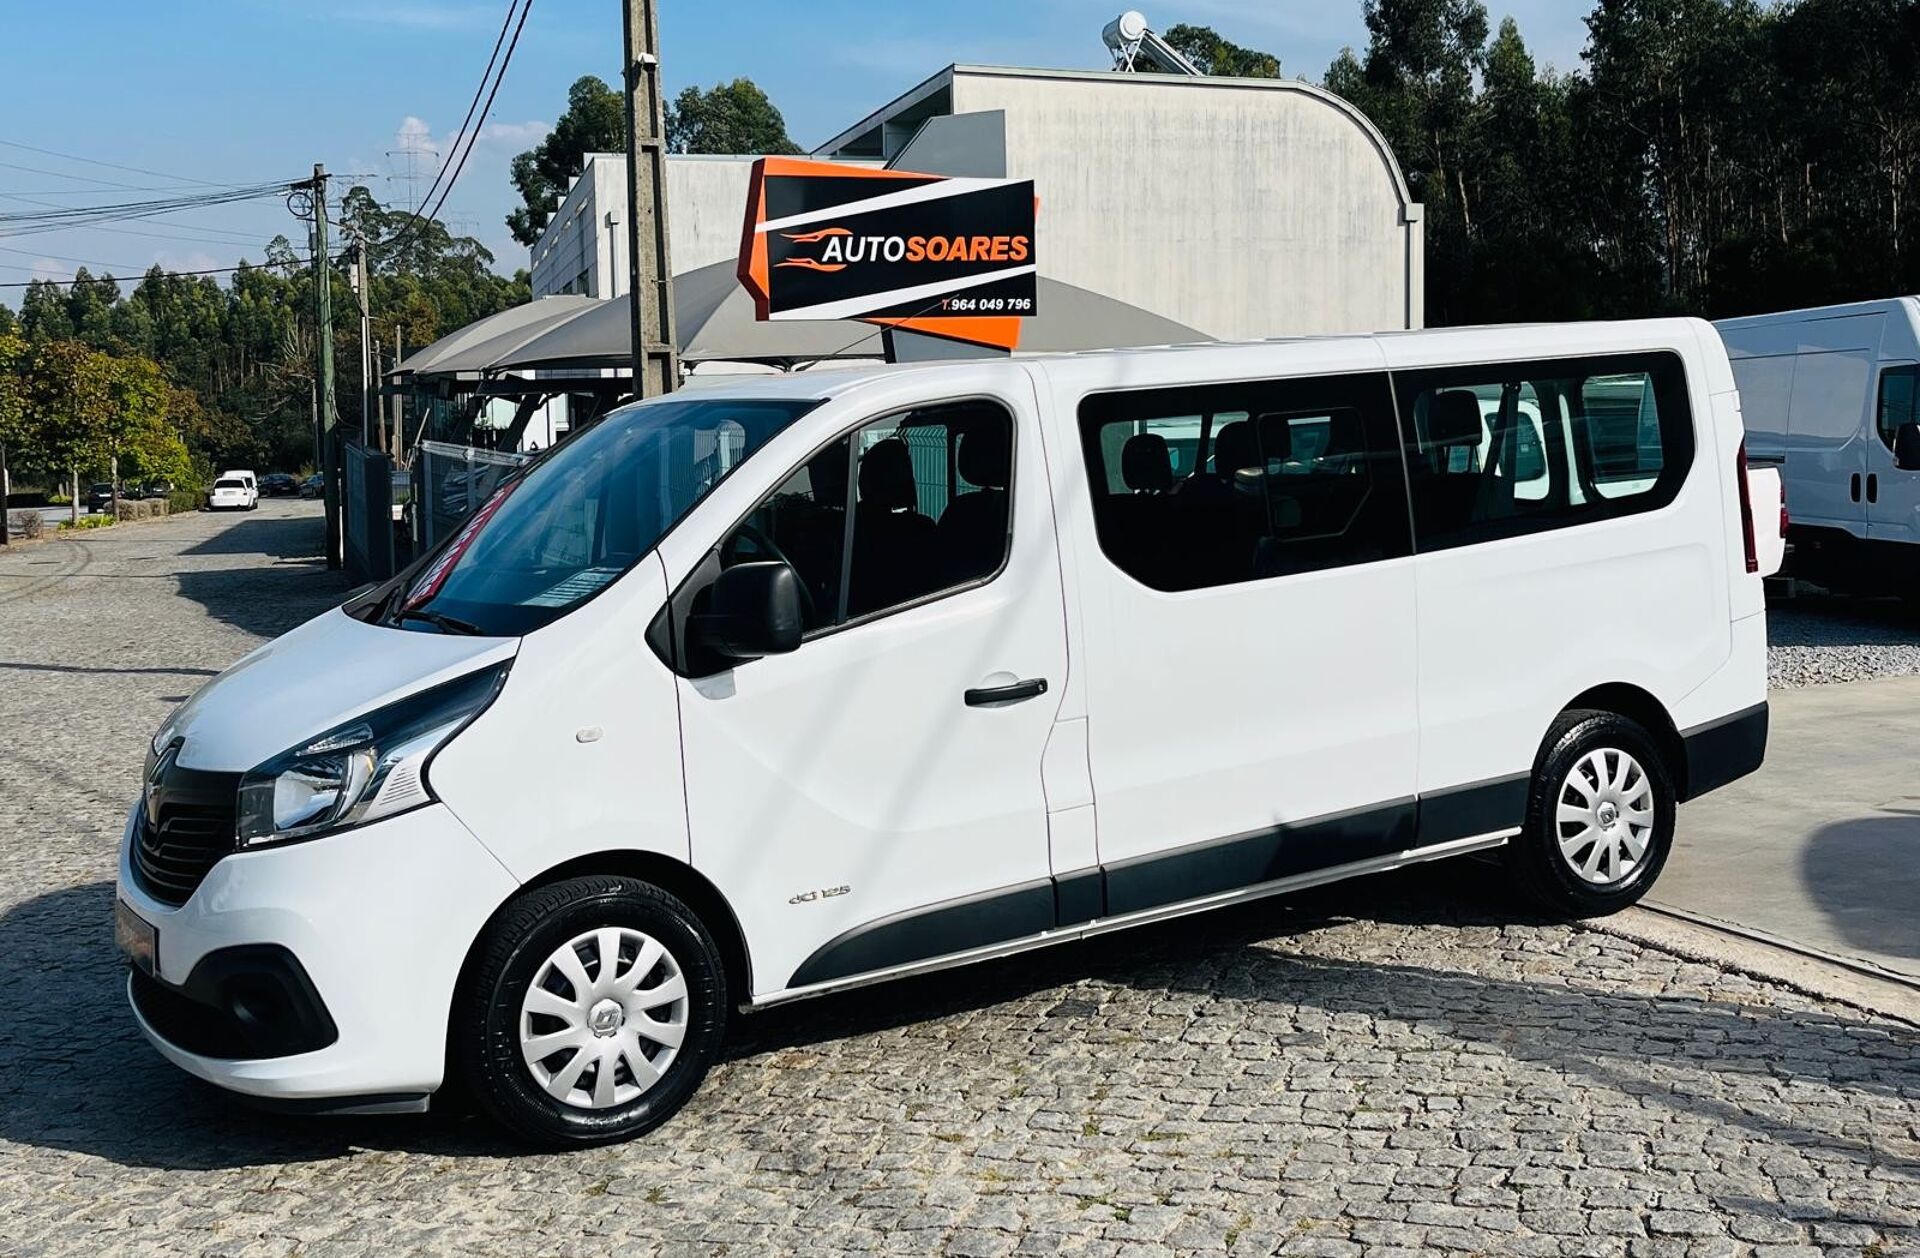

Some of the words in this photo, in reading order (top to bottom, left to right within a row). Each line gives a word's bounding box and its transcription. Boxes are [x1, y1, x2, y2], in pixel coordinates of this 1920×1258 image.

[979, 298, 1004, 310] 049
[1007, 298, 1031, 310] 796
[821, 885, 851, 898] 125
